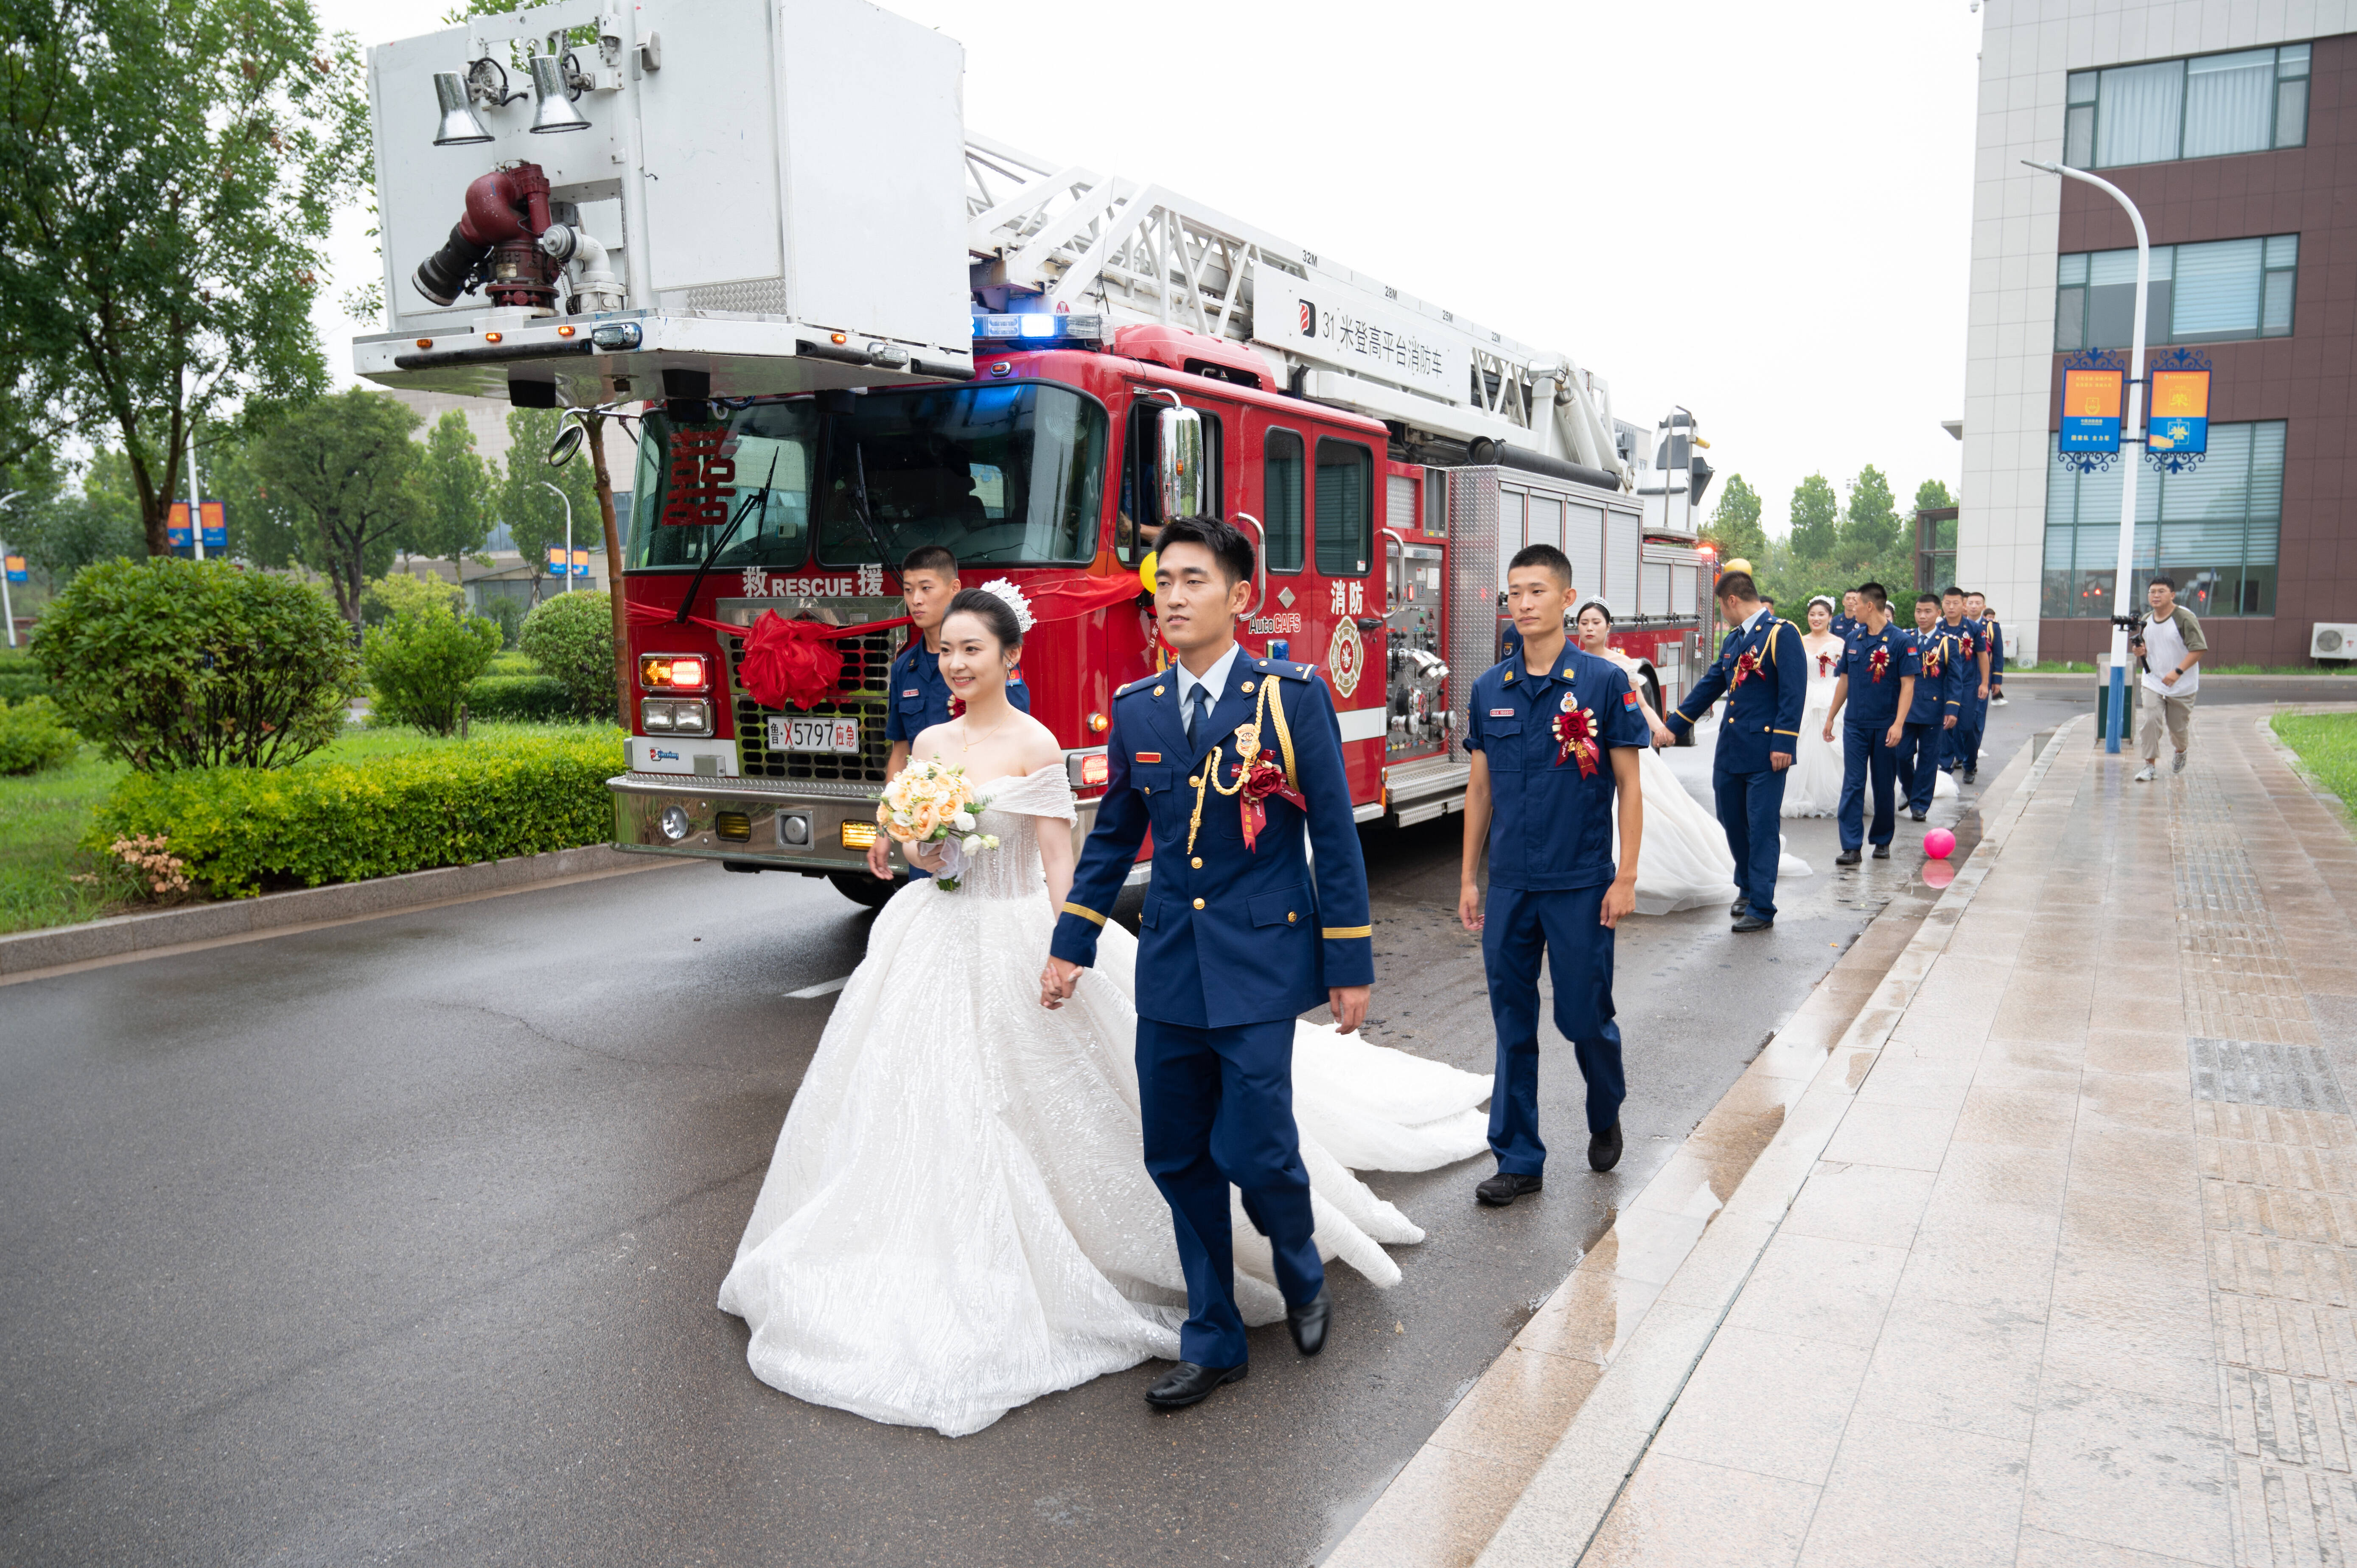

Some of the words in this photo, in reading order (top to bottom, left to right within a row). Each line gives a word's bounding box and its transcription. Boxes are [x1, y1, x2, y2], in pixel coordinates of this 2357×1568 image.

[1302, 249, 1318, 268] 32M
[1385, 286, 1397, 302] 28M
[1442, 310, 1454, 324] 25M
[1491, 331, 1501, 343] 22M
[742, 566, 768, 598] 救
[772, 577, 853, 597] RESCUE
[857, 563, 884, 596] 援
[1331, 580, 1363, 615] 消防
[1248, 613, 1301, 634] AutoCAFS
